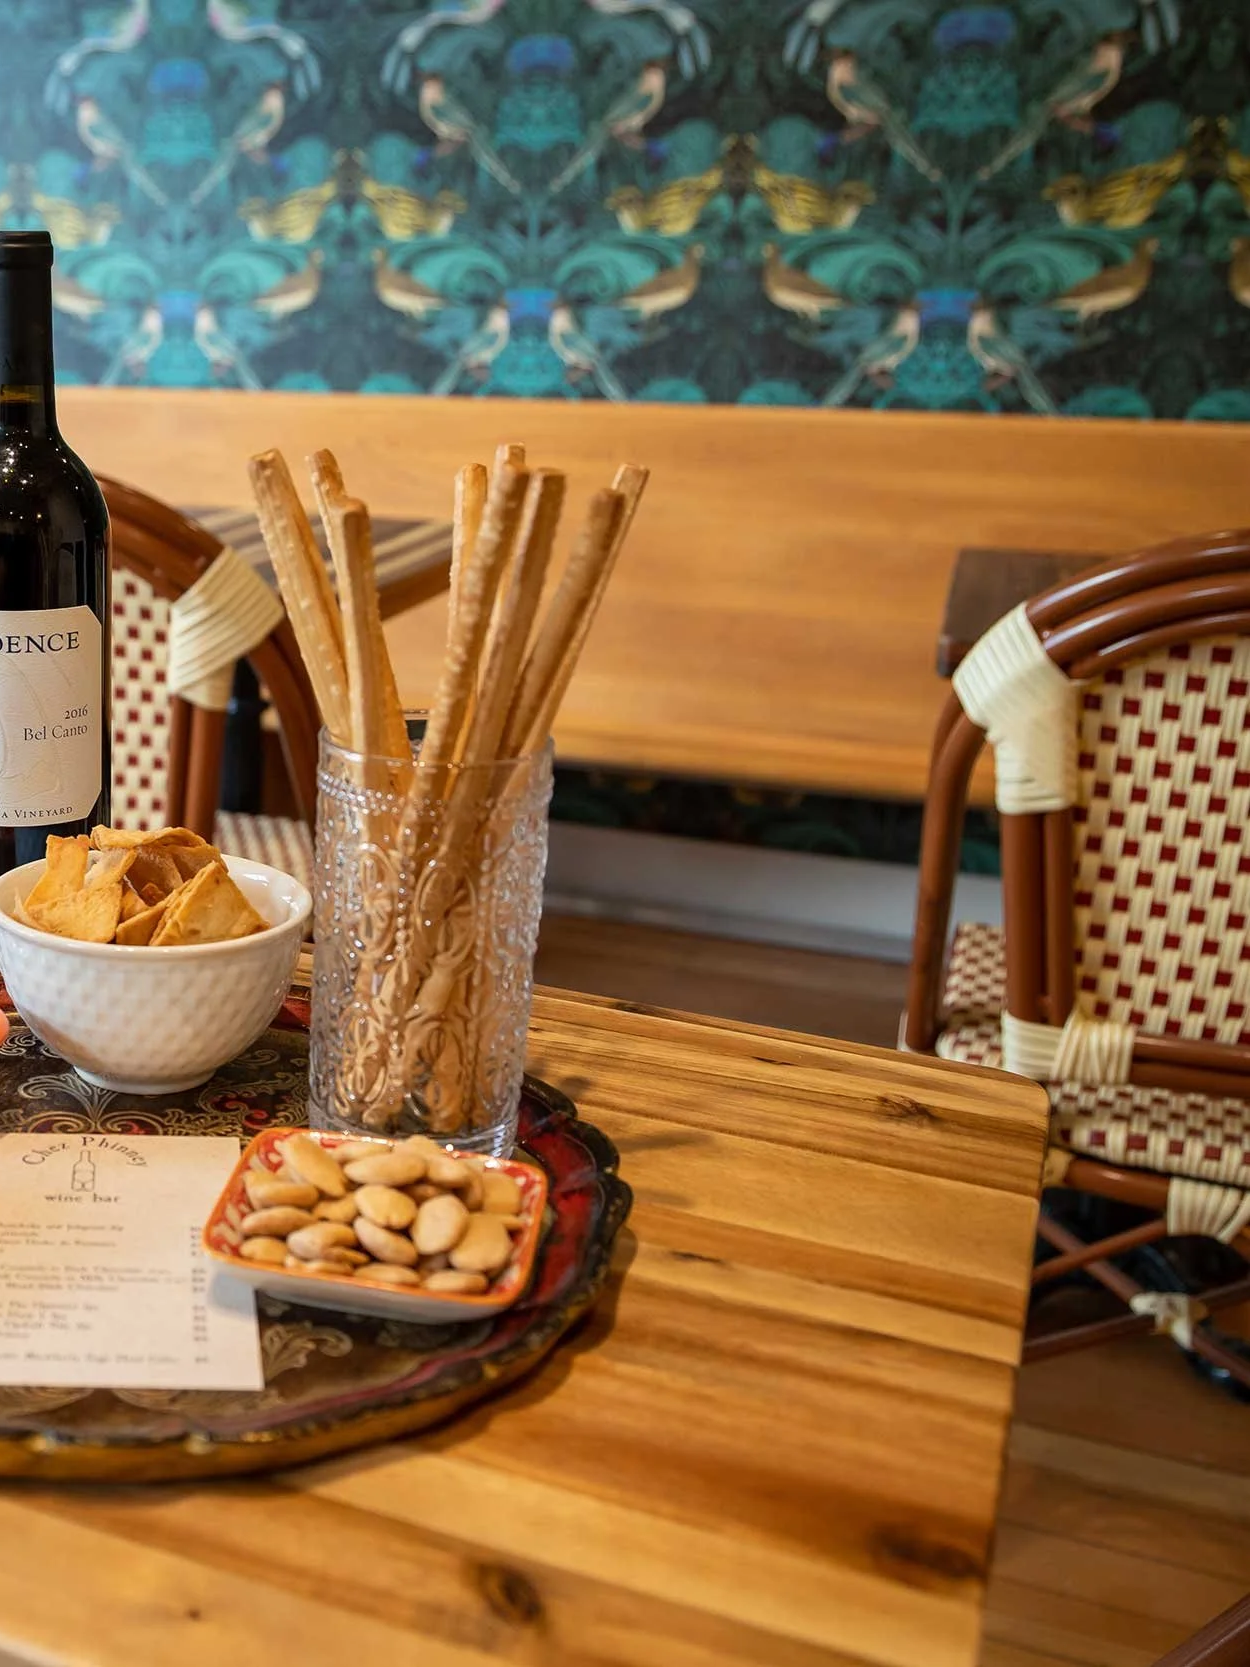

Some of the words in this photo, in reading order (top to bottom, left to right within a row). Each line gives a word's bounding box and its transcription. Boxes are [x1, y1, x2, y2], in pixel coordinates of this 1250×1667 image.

[64, 704, 88, 720] 2016
[23, 726, 47, 741] Bel
[52, 724, 88, 740] Canto
[14, 806, 73, 818] VINEYARD
[22, 1142, 71, 1165] Chez
[81, 1136, 149, 1167] Phinney
[43, 1193, 82, 1203] wine
[93, 1192, 122, 1203] bar
